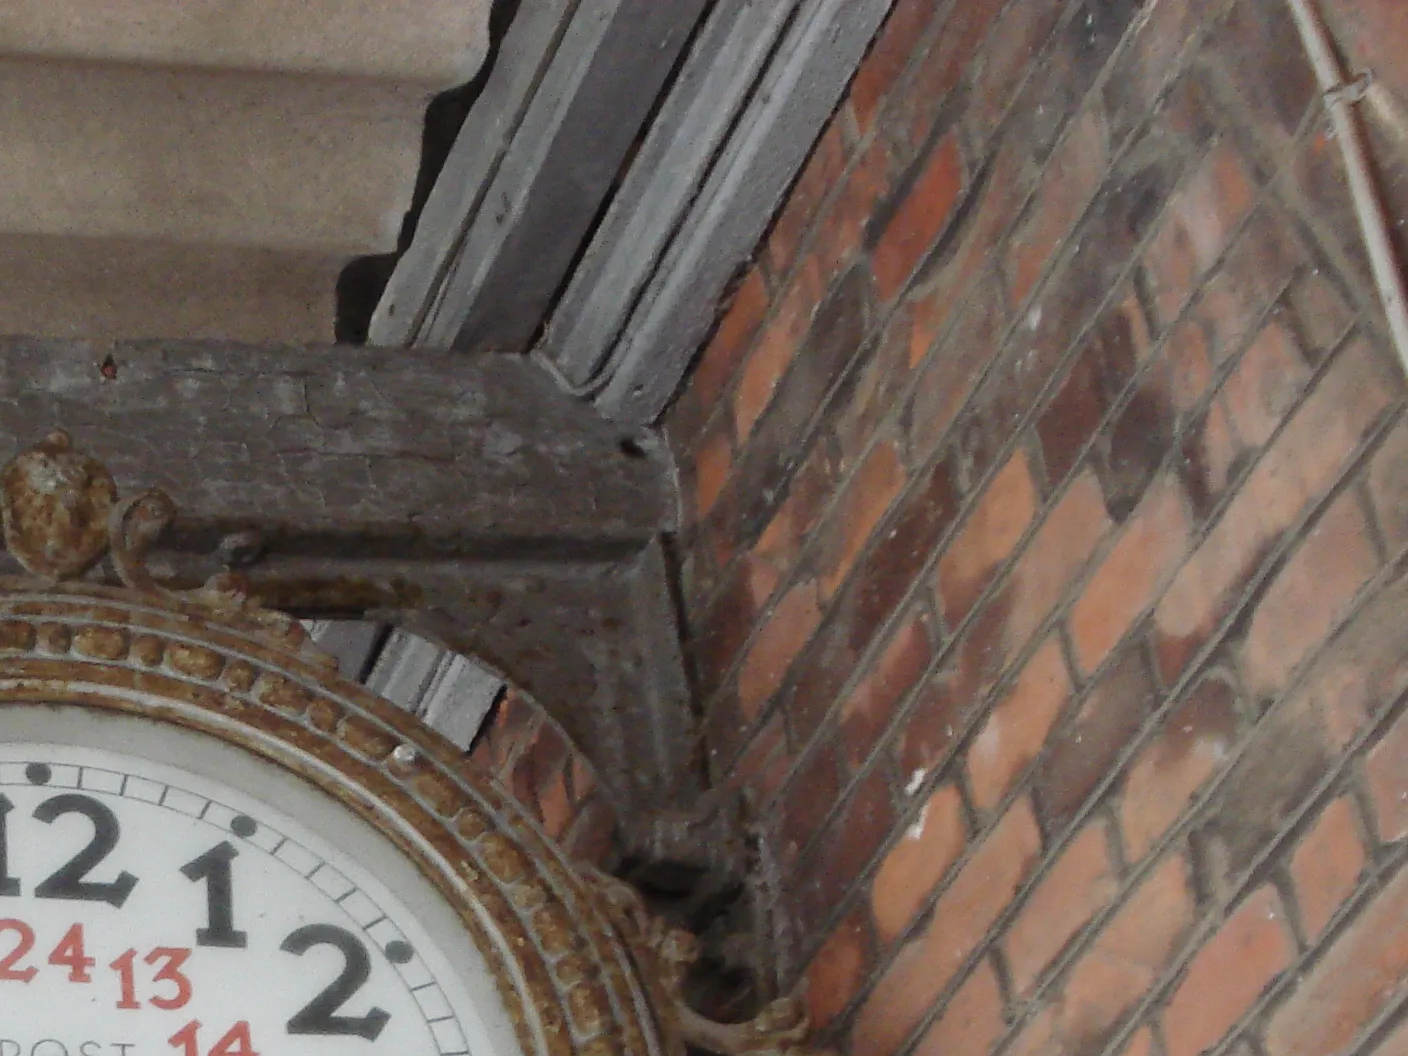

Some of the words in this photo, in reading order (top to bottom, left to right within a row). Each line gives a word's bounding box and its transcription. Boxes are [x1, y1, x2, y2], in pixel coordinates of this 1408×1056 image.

[179, 840, 247, 948] 1
[109, 947, 193, 1011] 13
[280, 923, 391, 1042] 2
